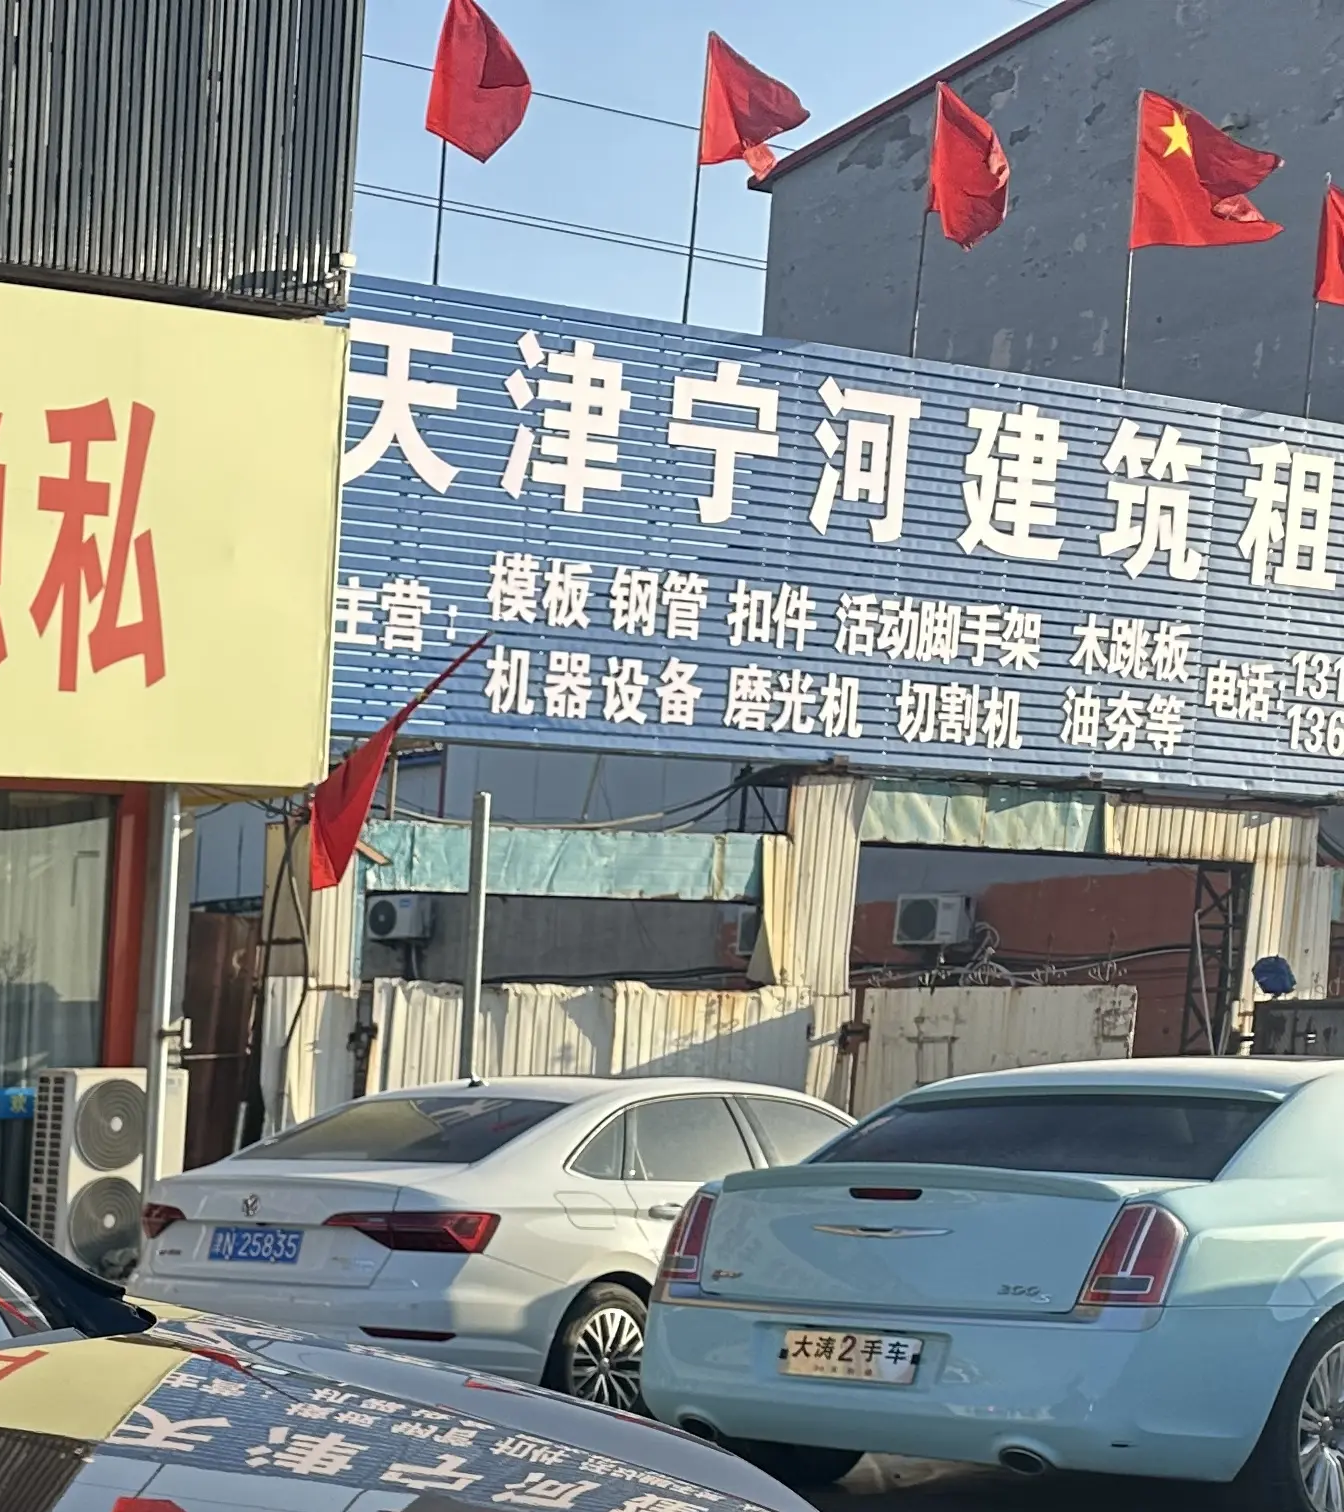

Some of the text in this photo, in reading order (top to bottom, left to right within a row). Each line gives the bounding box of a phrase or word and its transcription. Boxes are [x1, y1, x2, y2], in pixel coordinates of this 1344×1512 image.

[343, 316, 1339, 591] 天津宁河建筑租
[487, 550, 594, 629] 模板
[609, 566, 709, 641] 钢管
[726, 578, 818, 652] 扣件
[834, 590, 1043, 672] 活动脚手架
[1069, 613, 1192, 684] 木跳板
[484, 645, 703, 727] 机器设备
[722, 663, 863, 740] 磨光机
[895, 679, 1023, 751] 切割机
[791, 1334, 910, 1365] 大涛2手车
